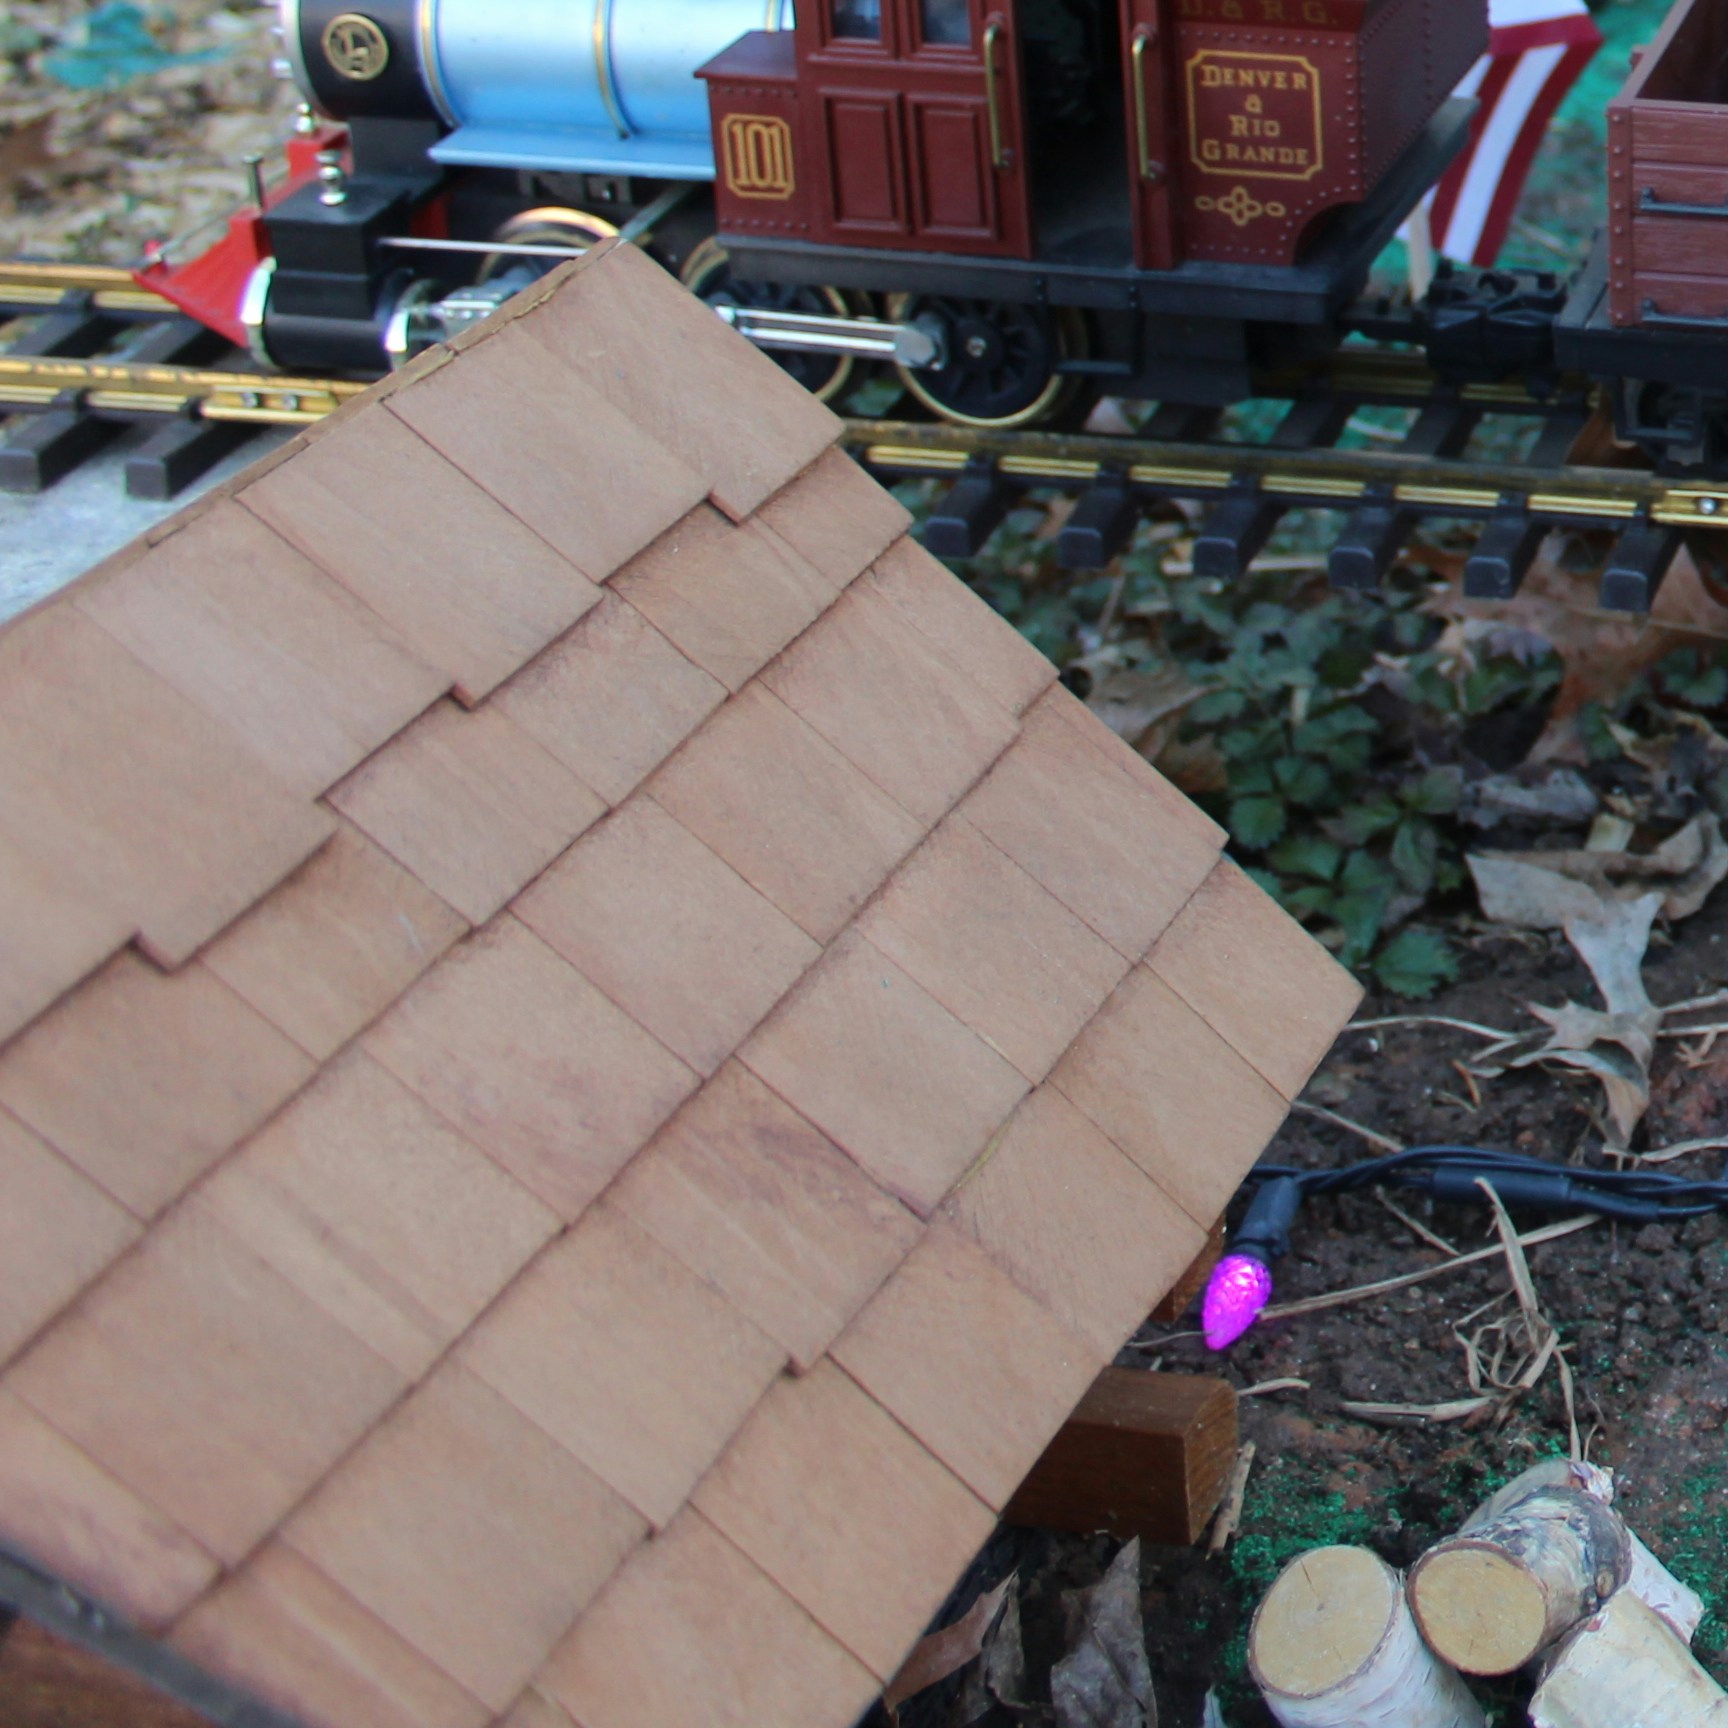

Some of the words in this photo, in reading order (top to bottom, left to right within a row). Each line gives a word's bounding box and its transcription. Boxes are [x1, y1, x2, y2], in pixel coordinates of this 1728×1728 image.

[1201, 64, 1308, 90] DENVER
[1245, 94, 1262, 114] &
[1229, 114, 1281, 137] RIO
[731, 122, 788, 188] 101
[1202, 138, 1309, 165] GRANDE
